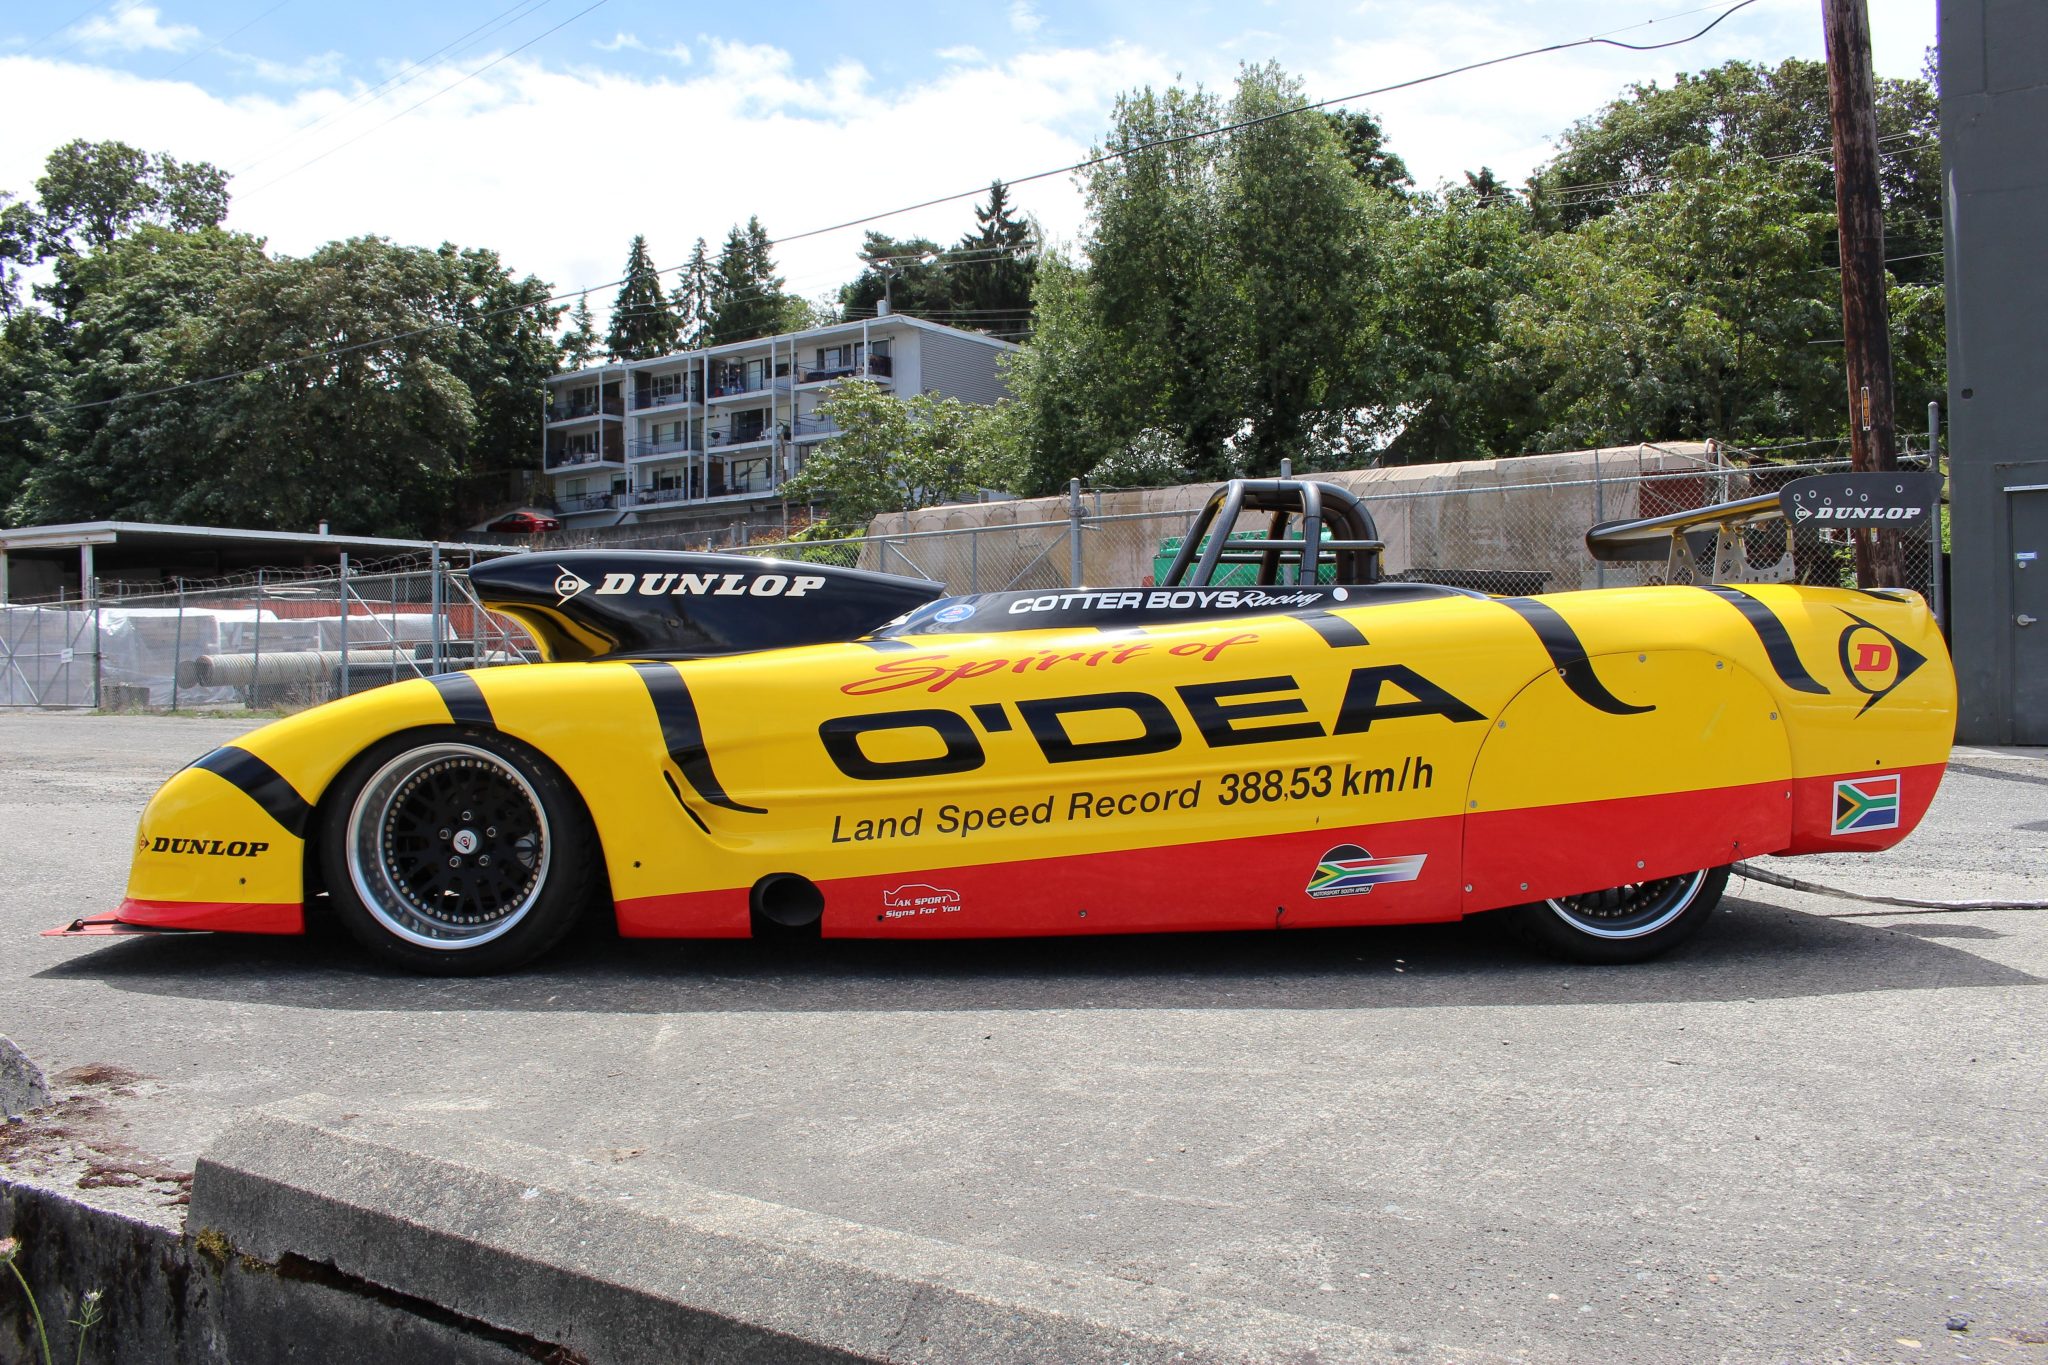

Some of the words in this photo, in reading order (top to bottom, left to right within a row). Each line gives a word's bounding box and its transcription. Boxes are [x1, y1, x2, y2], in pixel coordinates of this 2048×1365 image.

[1814, 507, 1921, 519] DUNLOP
[595, 573, 826, 597] DUNLOP
[1008, 592, 1144, 614] COTTER
[1146, 591, 1240, 609] BOYS
[1234, 590, 1324, 609] Racing
[840, 643, 1152, 696] Spirit
[1168, 633, 1260, 662] of
[1854, 643, 1892, 672] D
[818, 664, 1490, 781] O'DEA
[831, 807, 923, 844] Land
[936, 795, 1055, 838] Speed
[1067, 780, 1202, 821] Record
[1217, 765, 1333, 806] 388,53
[1341, 756, 1434, 797] km/h
[151, 837, 269, 857] DUNLOP
[885, 909, 915, 918] Signs
[919, 907, 937, 915] For
[941, 905, 961, 913] You
[897, 899, 911, 907] AK
[914, 896, 947, 905] SPORT
